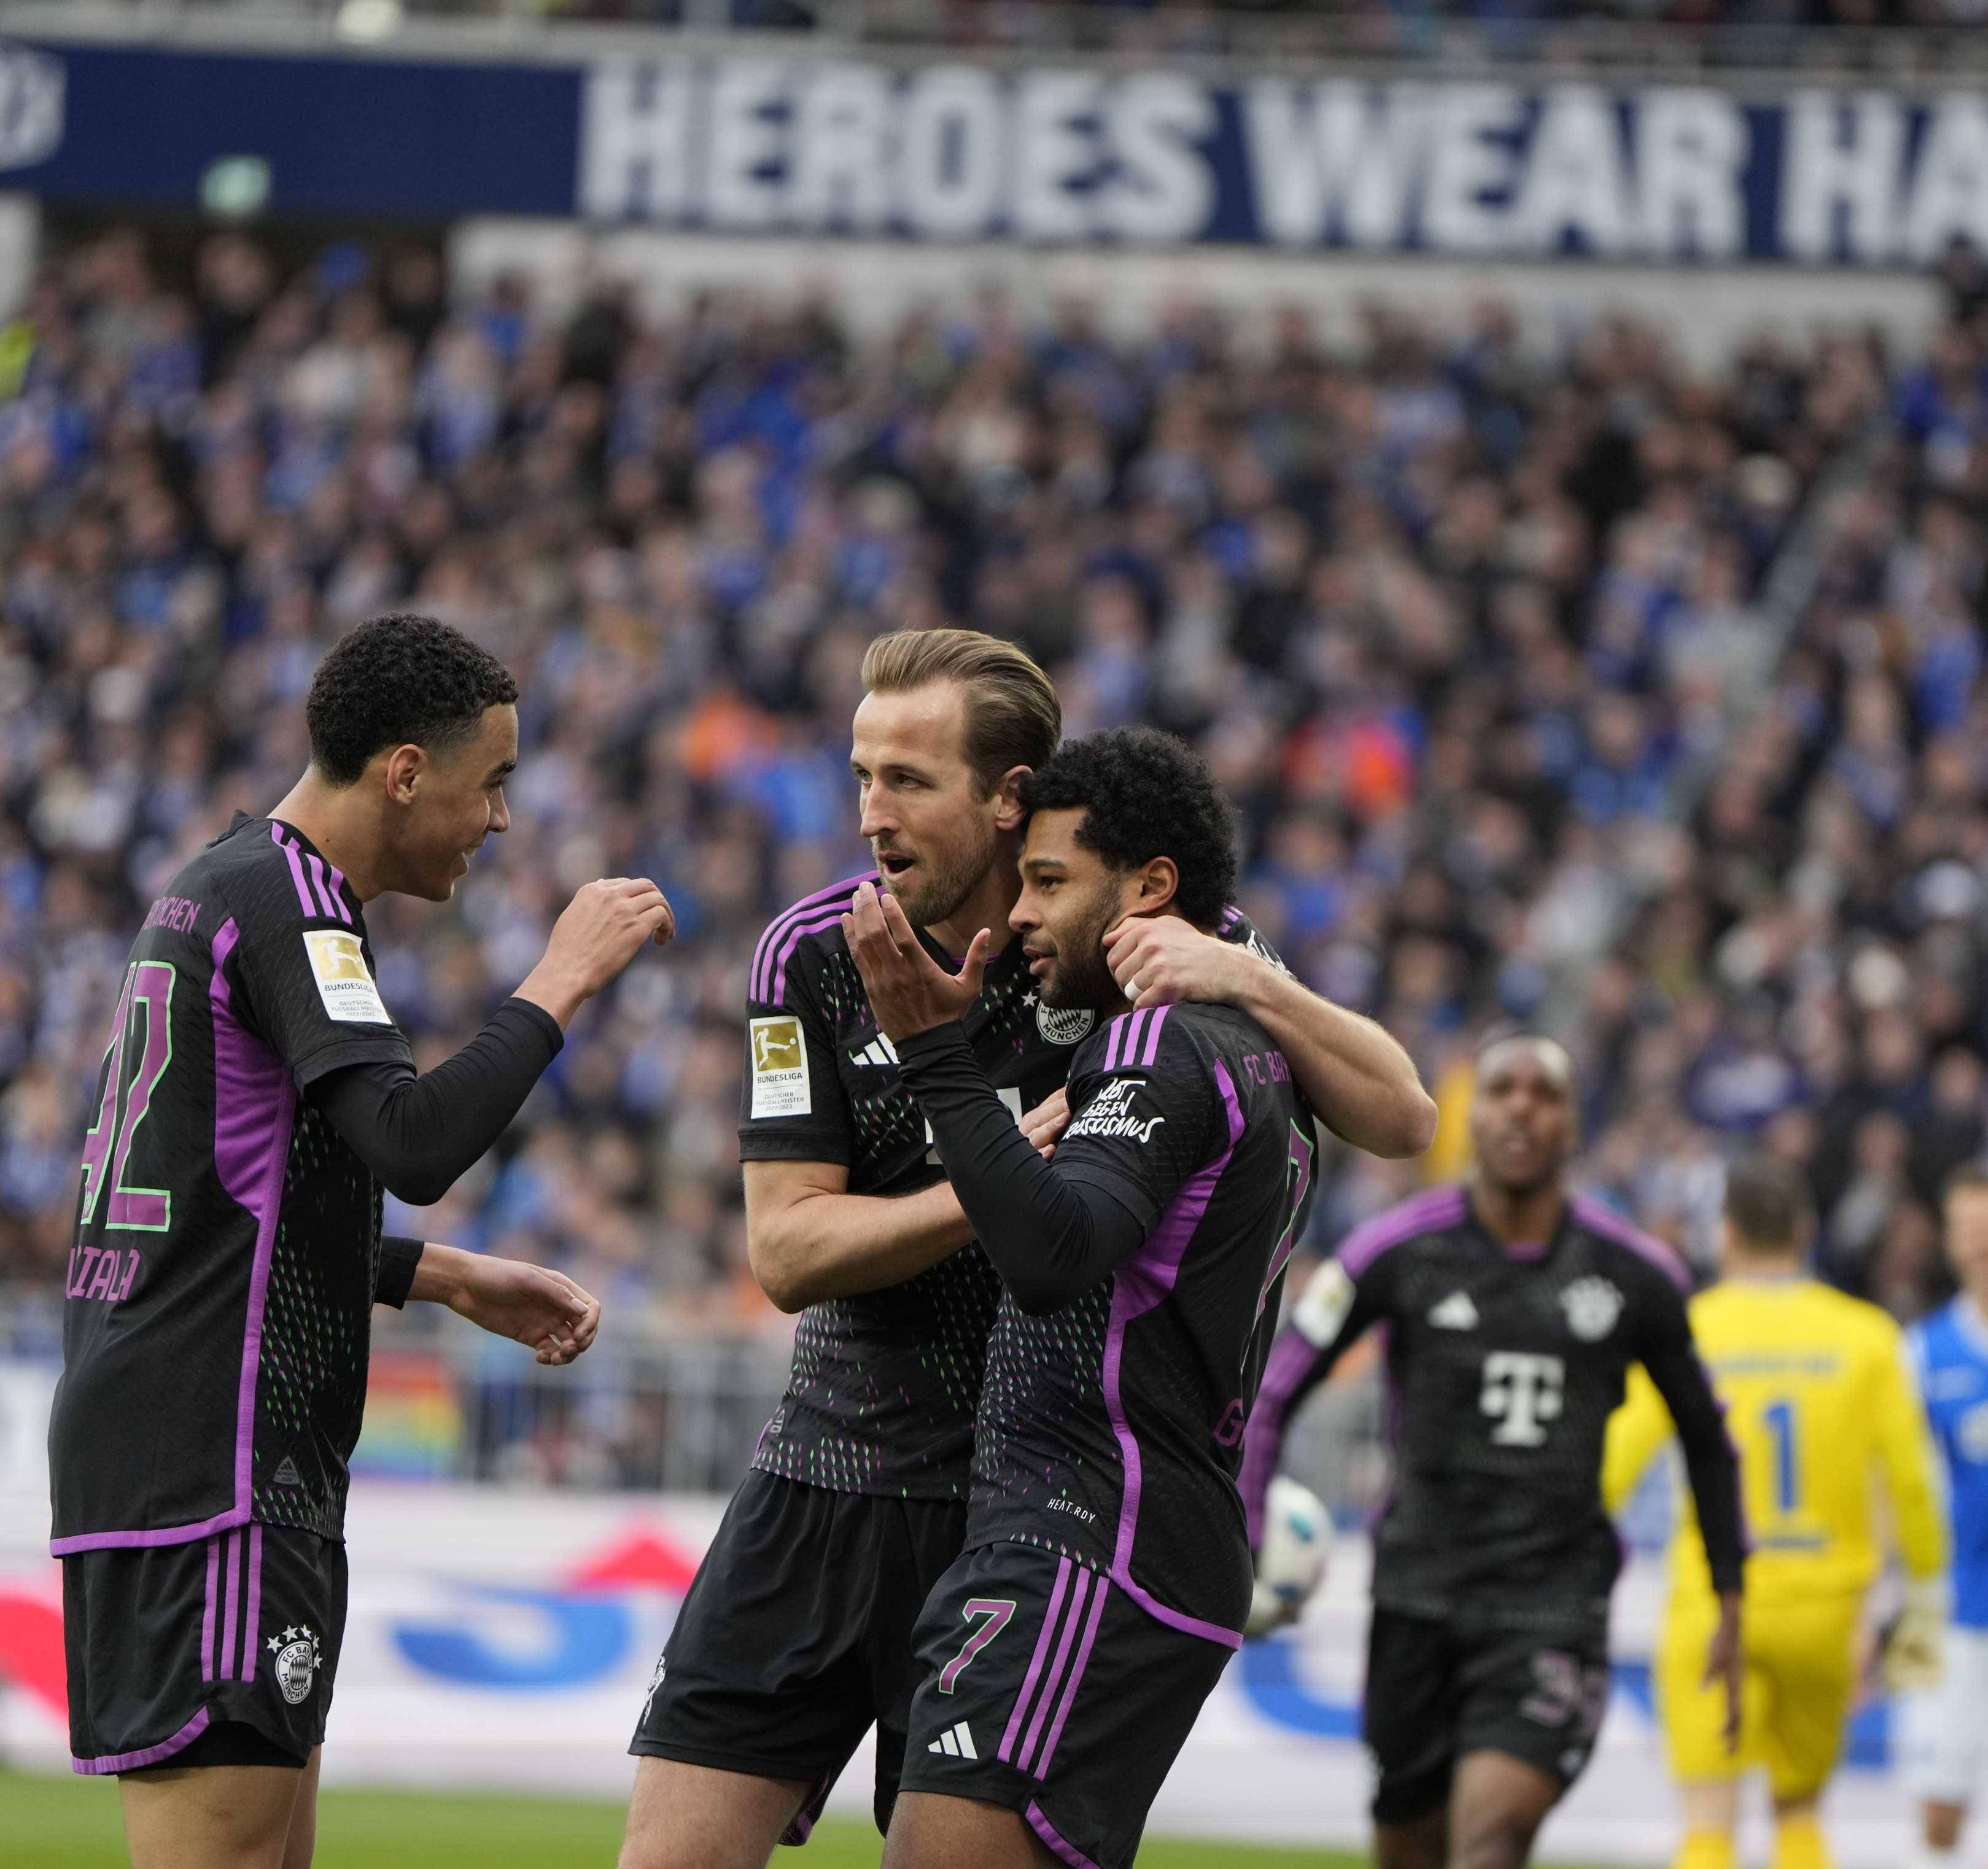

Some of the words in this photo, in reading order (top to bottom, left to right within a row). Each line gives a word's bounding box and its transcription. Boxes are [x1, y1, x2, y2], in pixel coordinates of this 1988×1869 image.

[577, 64, 1219, 236] HEROES
[1240, 81, 1747, 253] WEAR
[757, 1072, 803, 1084] BUNDESLIGA
[1082, 1091, 1136, 1117] GEGEN
[1092, 1076, 1146, 1104] ROT
[1481, 1352, 1565, 1447] T
[1761, 1400, 1798, 1513] 1
[1047, 1498, 1096, 1523] HEAT.RDY
[939, 1598, 1017, 1695] 7
